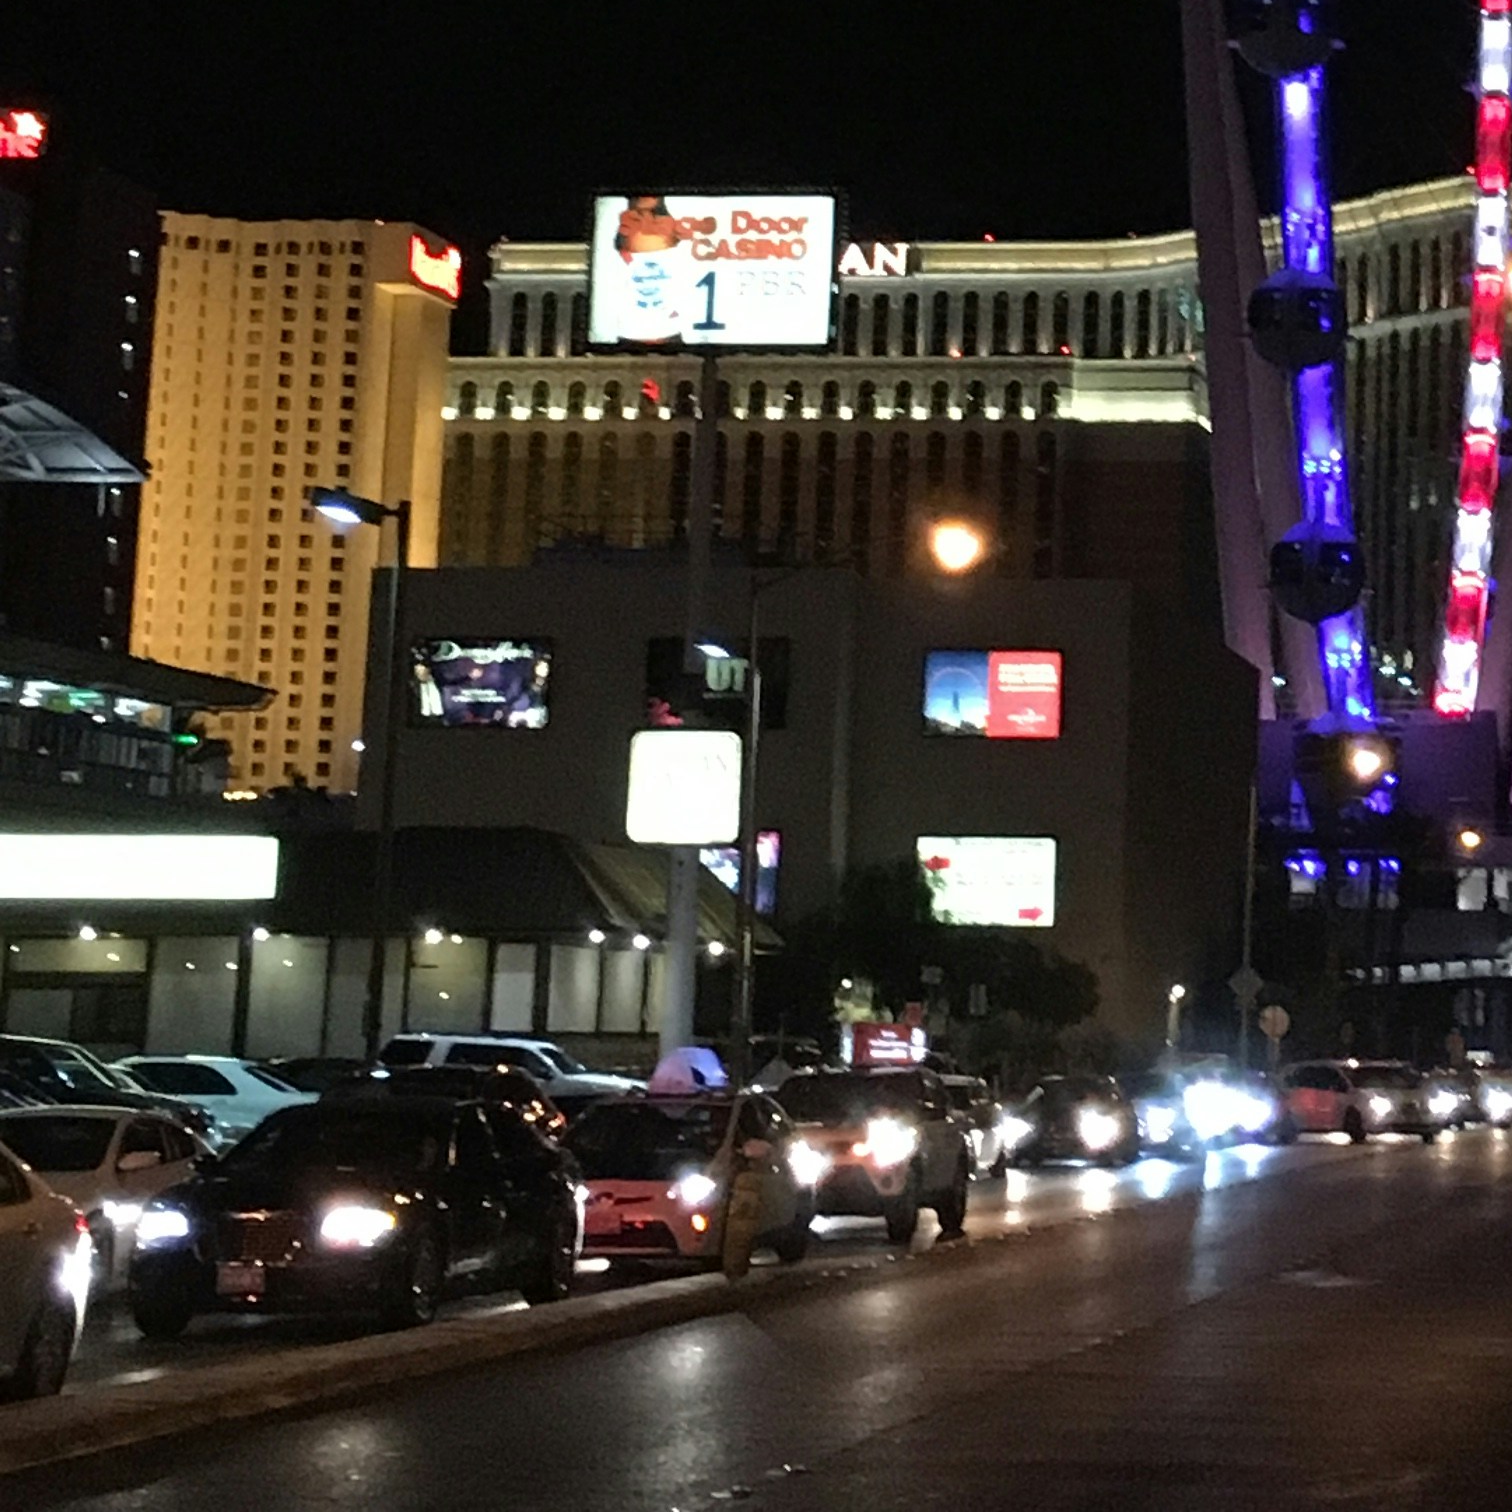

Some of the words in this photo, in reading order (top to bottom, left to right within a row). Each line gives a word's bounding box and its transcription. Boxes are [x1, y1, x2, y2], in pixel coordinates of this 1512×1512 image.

[731, 209, 808, 236] Door
[690, 237, 808, 261] CASINO
[692, 270, 726, 331] 1
